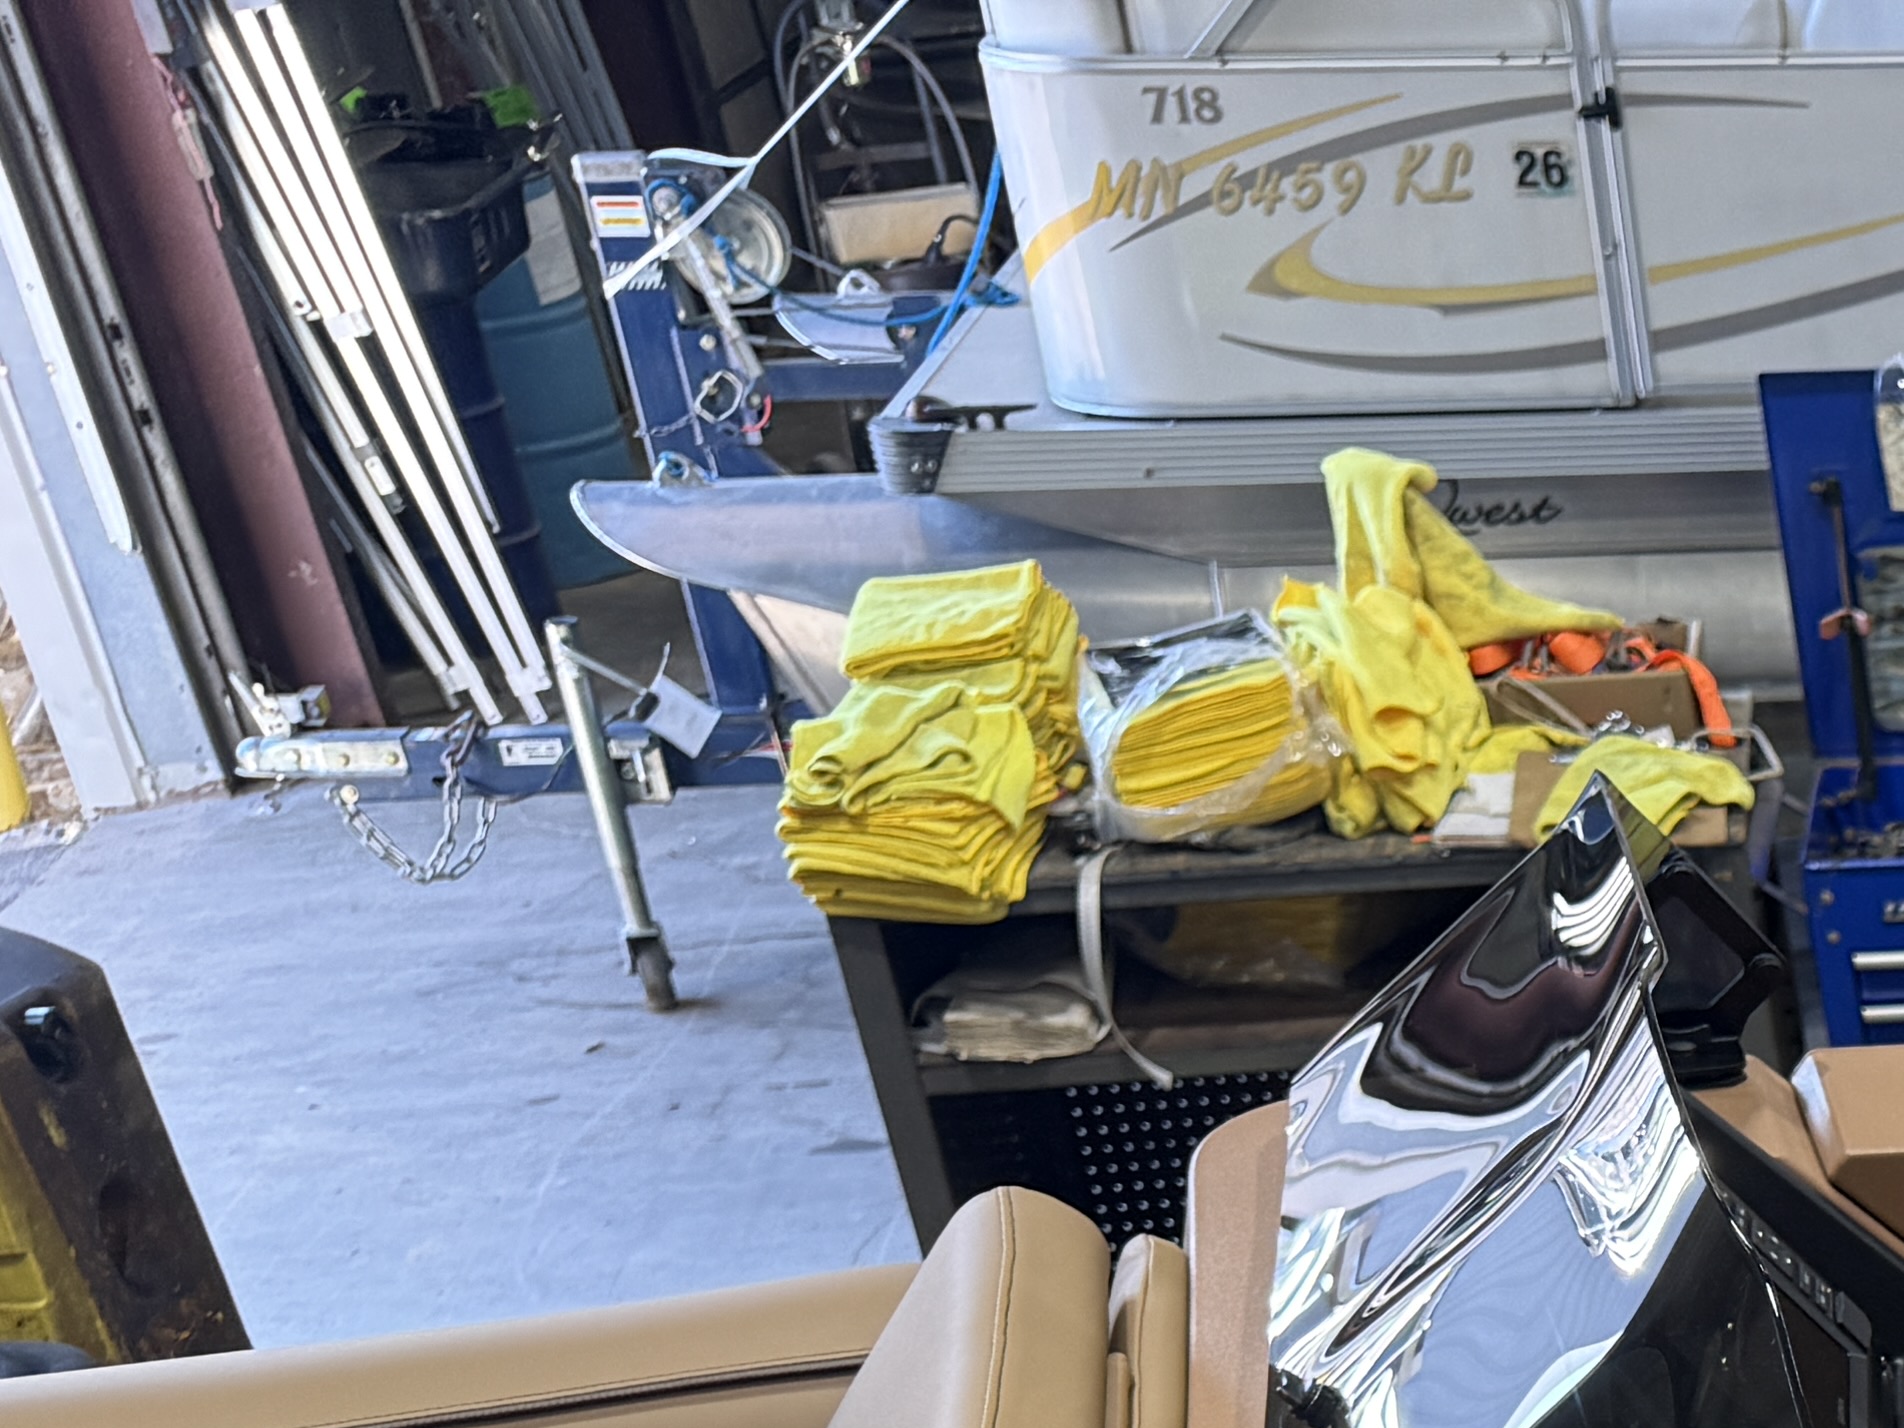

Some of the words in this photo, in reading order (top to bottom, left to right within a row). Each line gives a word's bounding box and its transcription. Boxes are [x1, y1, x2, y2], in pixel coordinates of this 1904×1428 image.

[1141, 85, 1223, 125] 718
[1514, 149, 1569, 189] 26
[1091, 157, 1186, 222] MN
[1210, 159, 1368, 217] 6459
